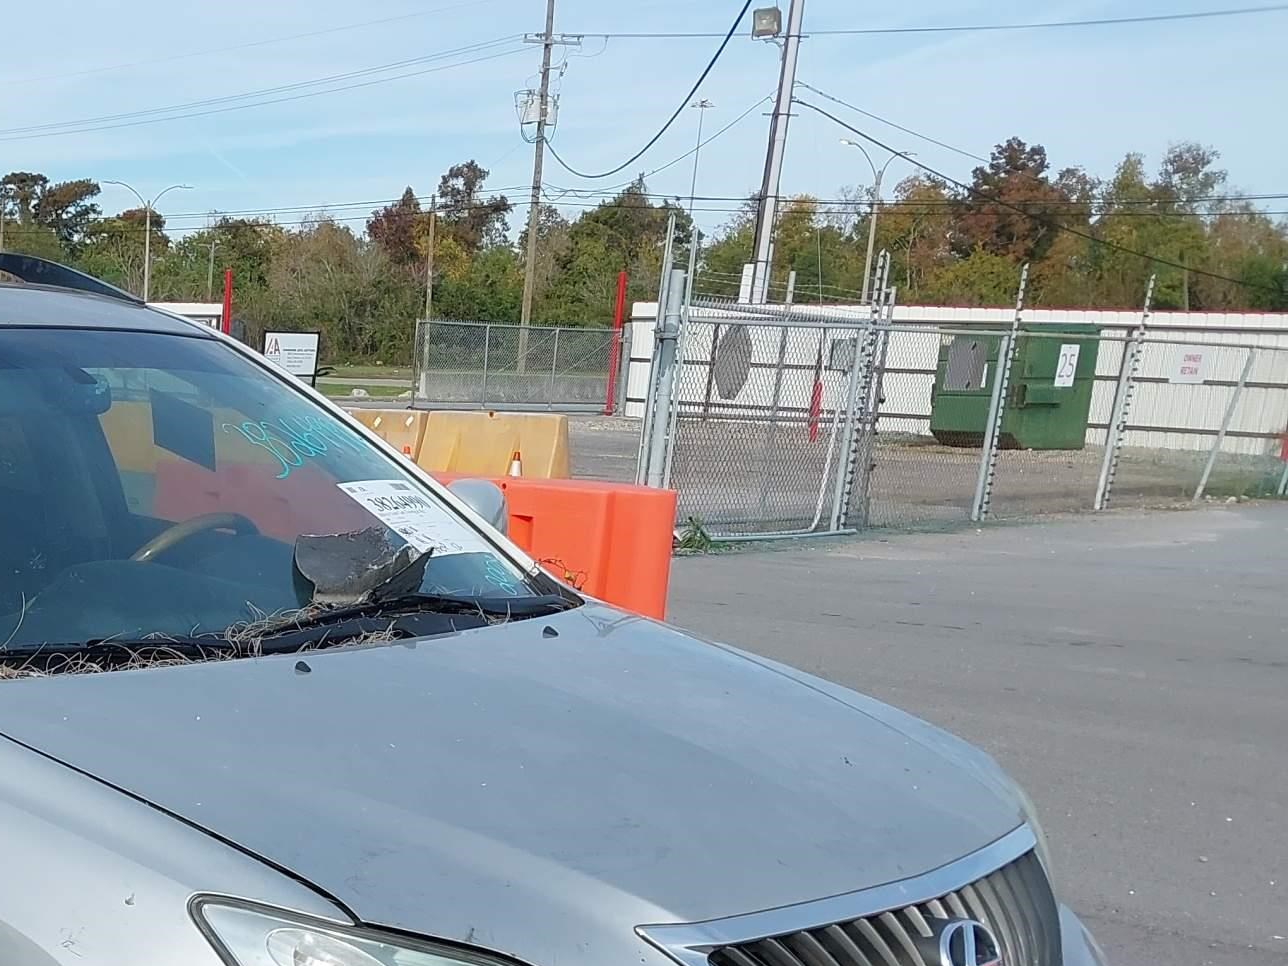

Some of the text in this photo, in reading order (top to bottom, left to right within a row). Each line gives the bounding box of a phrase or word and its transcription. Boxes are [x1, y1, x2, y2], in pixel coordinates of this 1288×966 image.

[1057, 353, 1076, 378] 25
[1183, 354, 1202, 363] OWNER
[367, 495, 431, 512] 38264990
